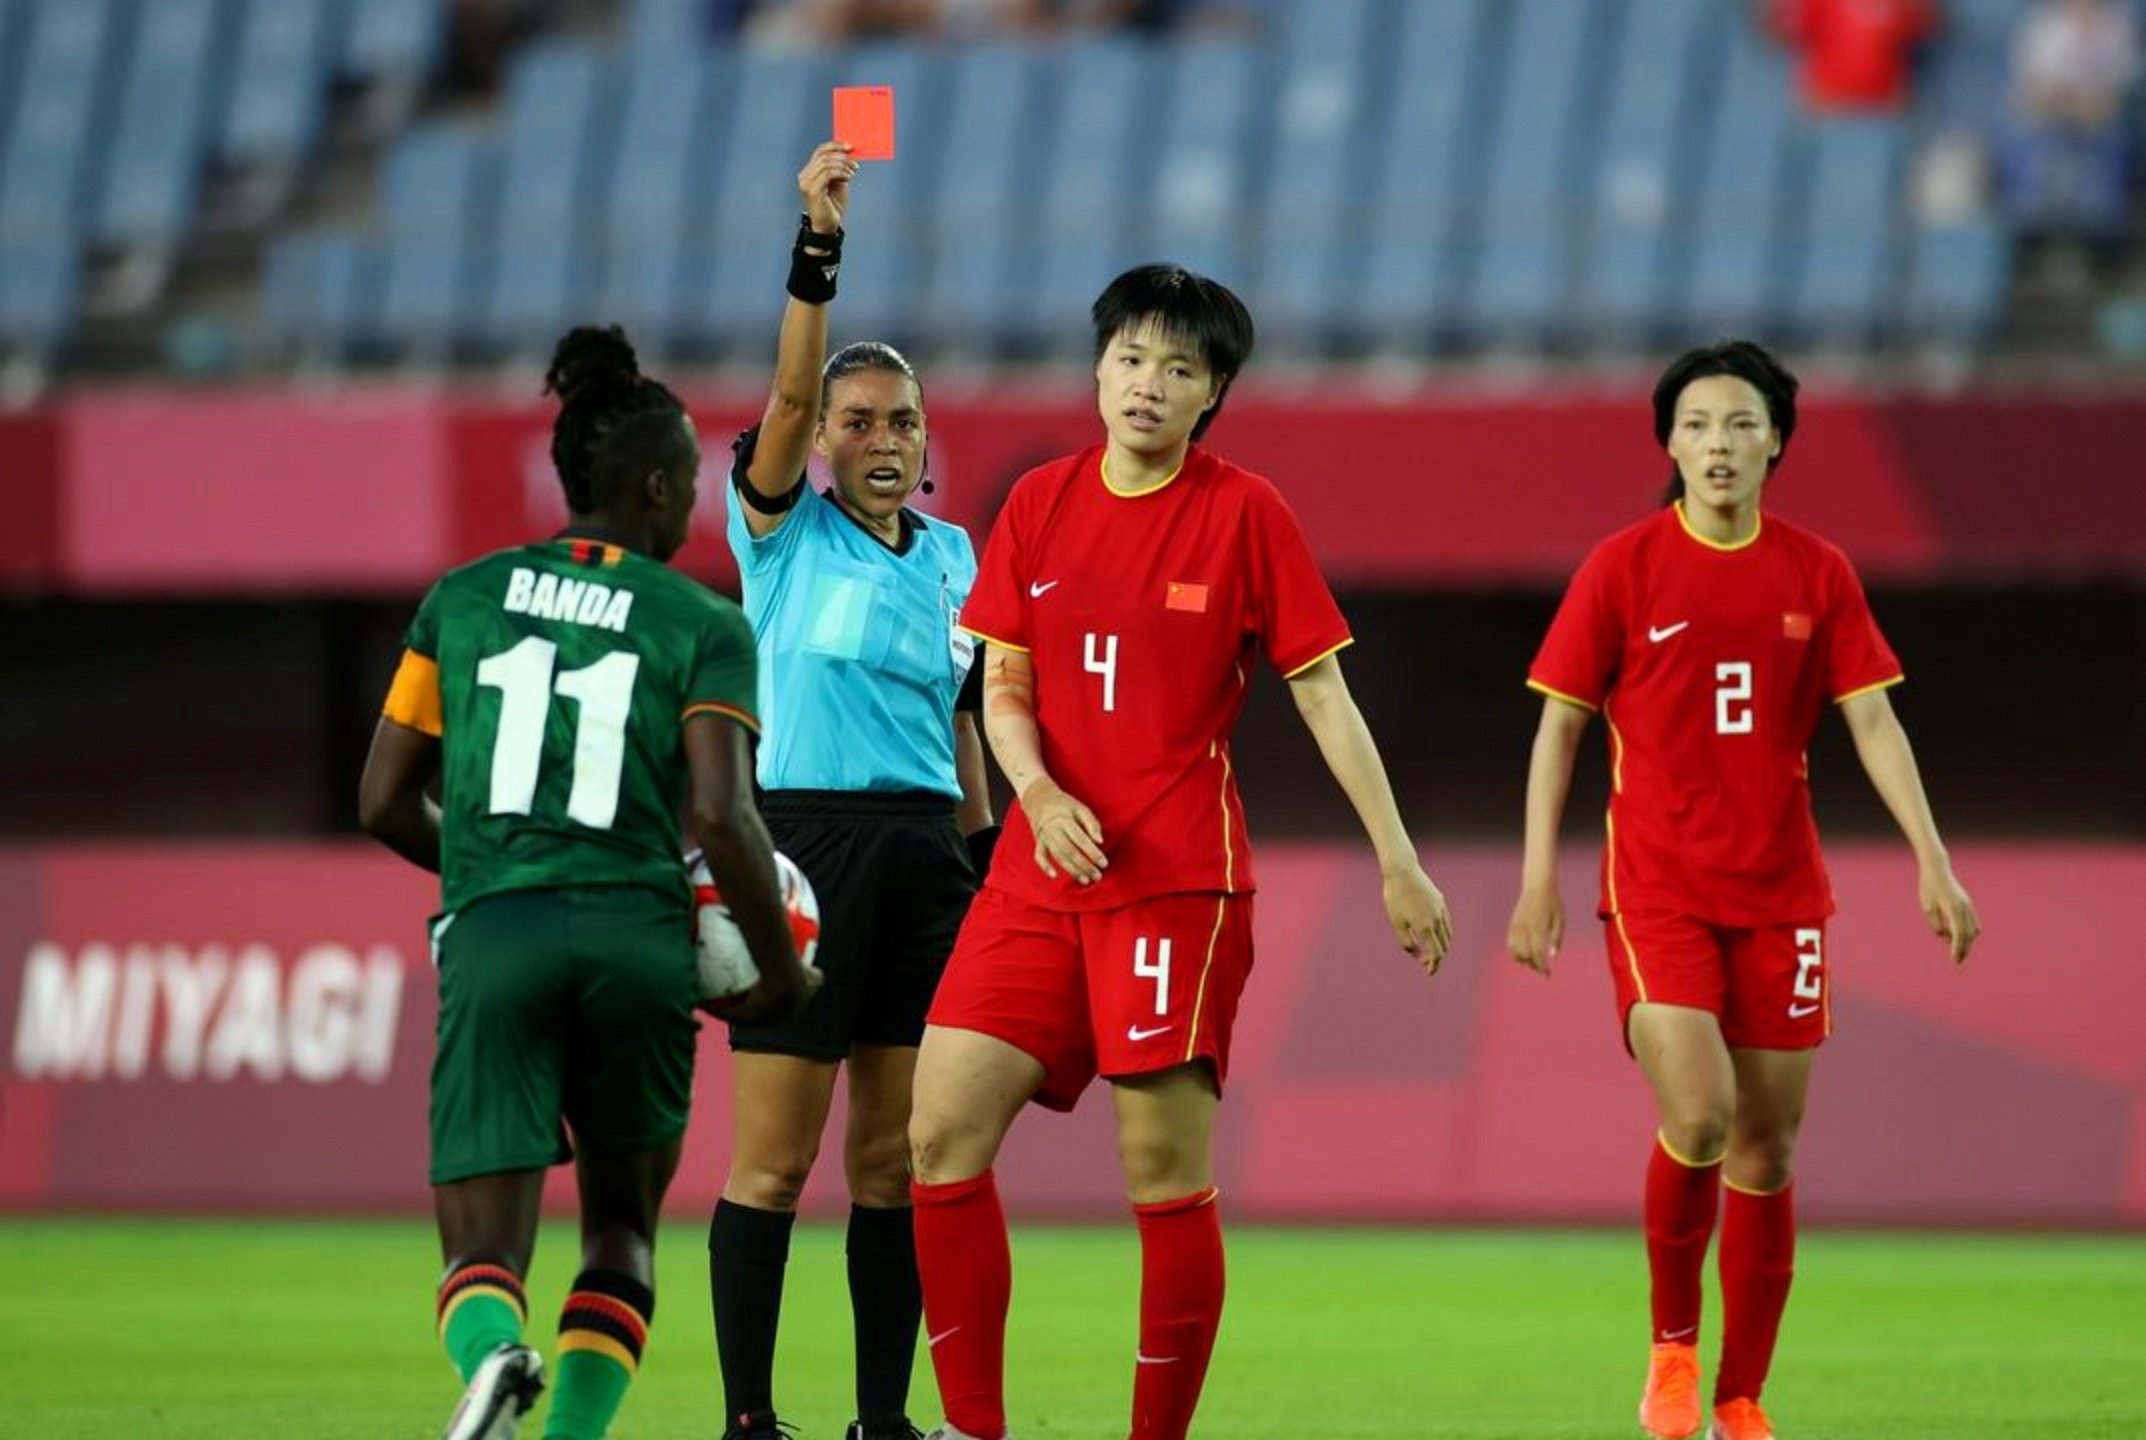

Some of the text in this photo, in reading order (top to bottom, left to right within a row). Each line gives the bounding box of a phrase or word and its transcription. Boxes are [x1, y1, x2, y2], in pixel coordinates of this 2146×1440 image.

[503, 567, 634, 632] BANDA
[1083, 632, 1119, 712] 4
[1715, 661, 1753, 735] 2
[476, 635, 640, 829] 11
[1133, 937, 1172, 1016] 4
[1793, 928, 1822, 1000] 2
[13, 943, 404, 1081] MIYAGI
